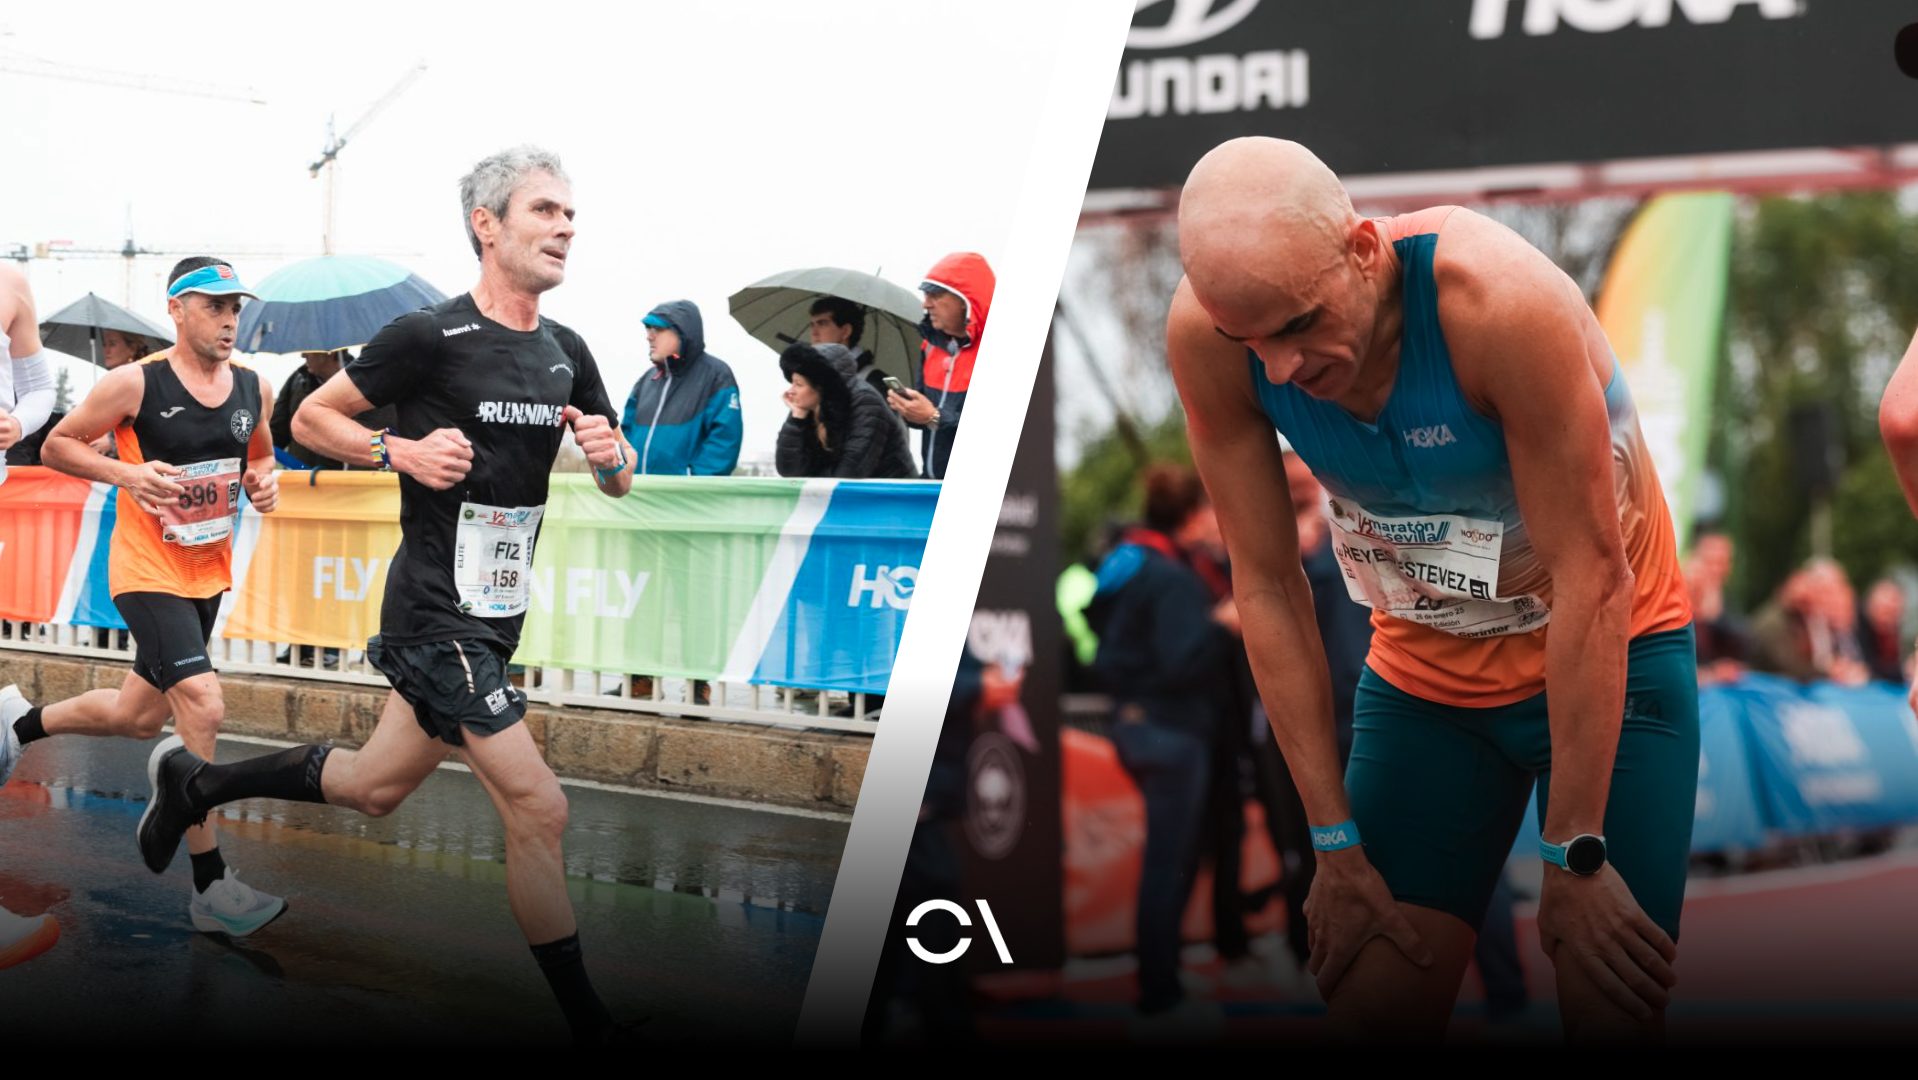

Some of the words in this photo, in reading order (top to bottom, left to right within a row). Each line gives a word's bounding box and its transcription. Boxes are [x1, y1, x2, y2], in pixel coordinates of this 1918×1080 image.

[1403, 424, 1457, 448] HOKA
[178, 482, 218, 509] 596
[1369, 520, 1434, 533] maratón
[457, 542, 465, 569] ELITE
[494, 541, 520, 560] FIZ
[313, 556, 379, 602] FLY
[492, 569, 519, 588] 158
[565, 565, 651, 619] FLY
[1458, 624, 1510, 639] Sprinter
[1313, 830, 1348, 846] HOKA
